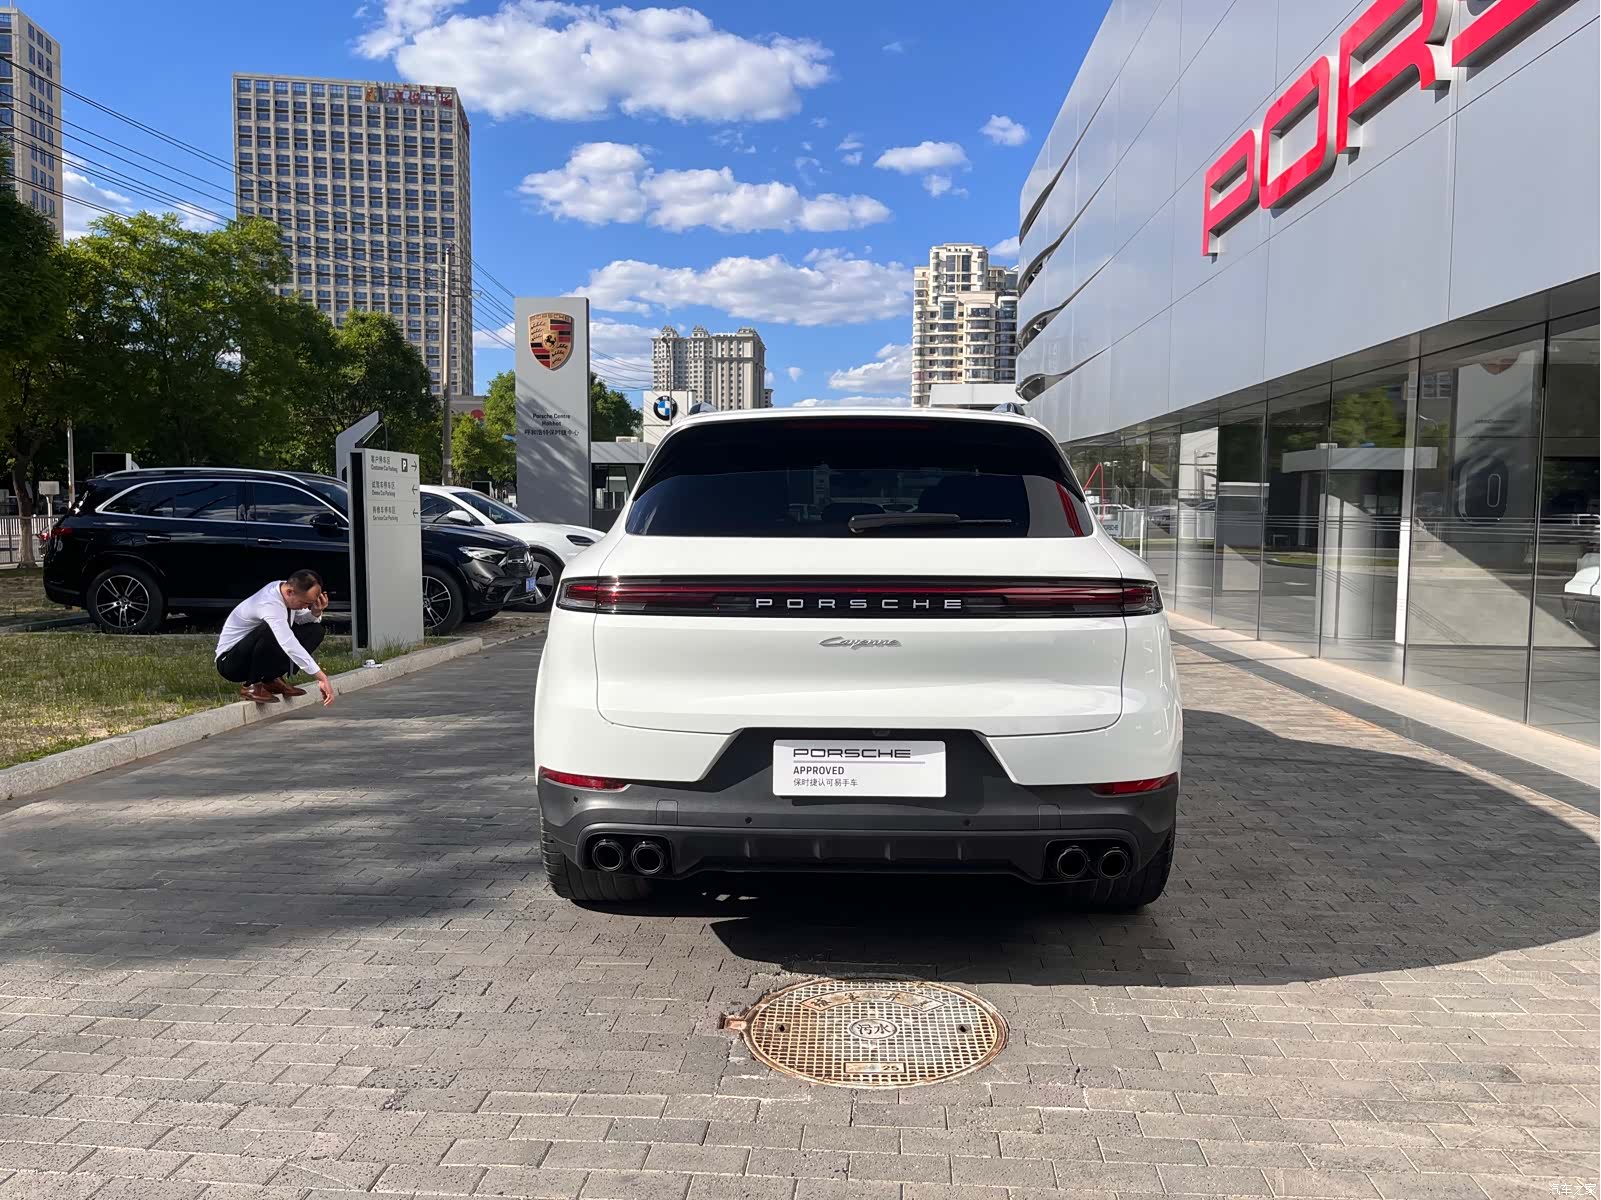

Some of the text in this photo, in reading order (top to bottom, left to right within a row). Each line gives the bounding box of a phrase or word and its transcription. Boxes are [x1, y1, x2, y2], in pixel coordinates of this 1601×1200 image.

[1202, 0, 1552, 257] POR
[755, 599, 962, 609] PORSCHE
[818, 635, 903, 651] Cayenne
[793, 748, 911, 759] PORSCHE
[793, 766, 845, 775] APPROVED
[793, 778, 858, 787] 保时捷认可易手车
[857, 1024, 891, 1035] 污水
